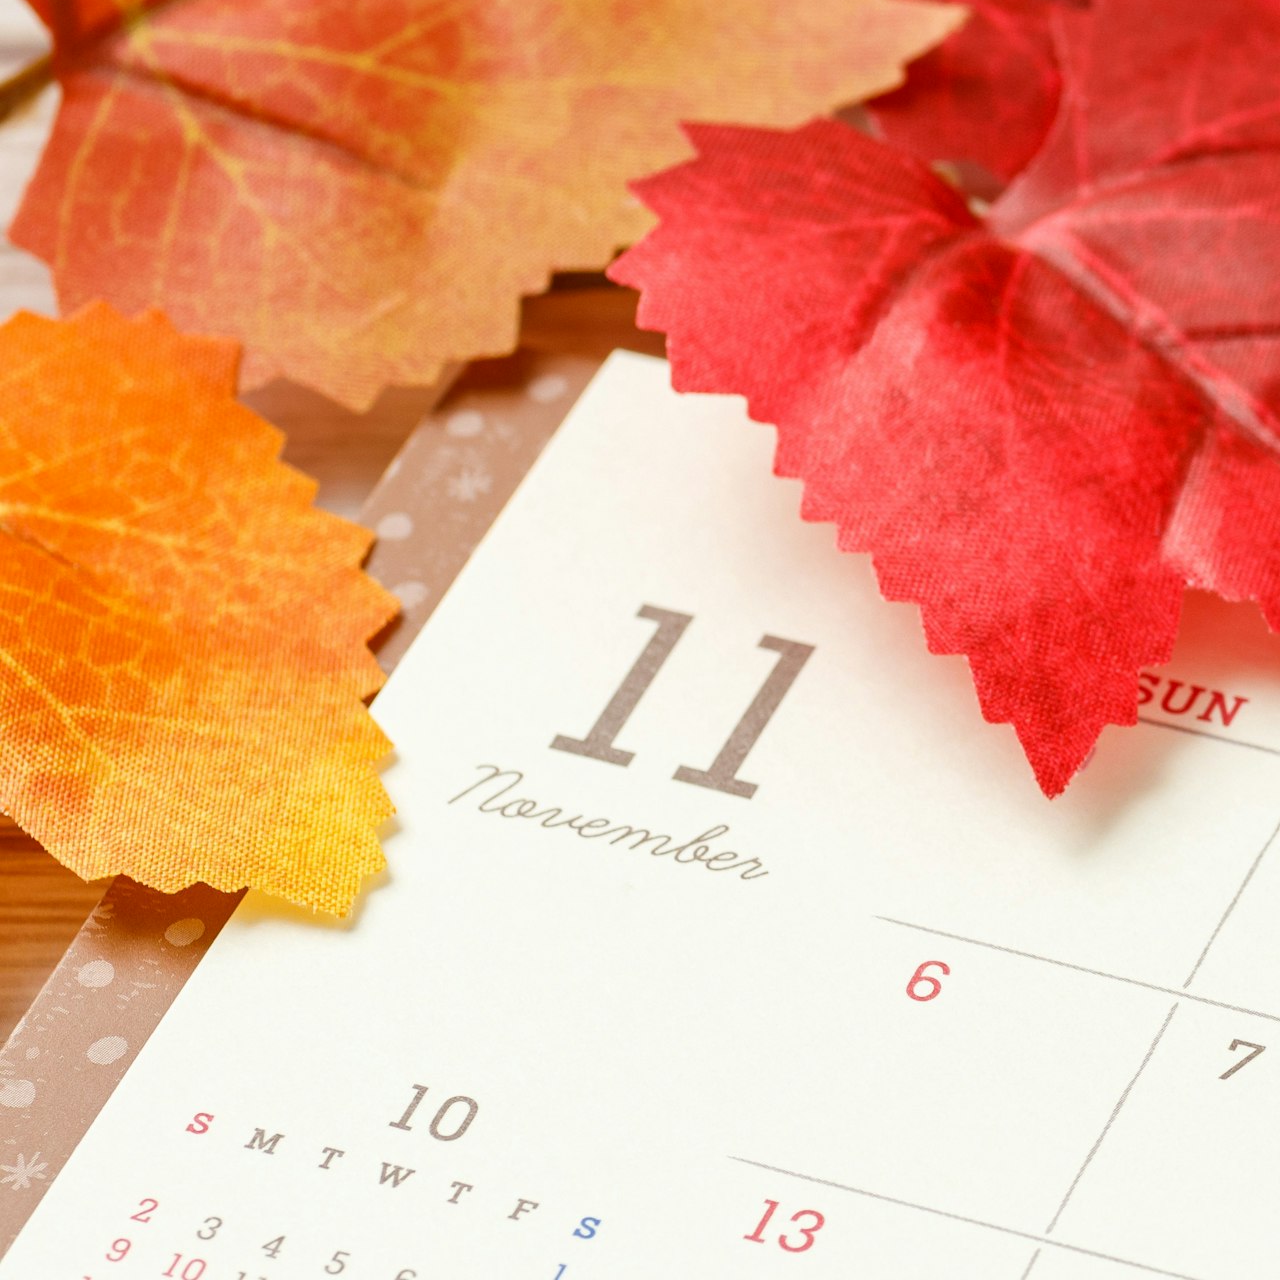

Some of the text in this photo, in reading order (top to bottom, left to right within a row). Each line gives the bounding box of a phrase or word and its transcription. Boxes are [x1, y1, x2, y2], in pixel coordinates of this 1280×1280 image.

[549, 603, 818, 800] 11
[1138, 673, 1249, 727] SUN
[447, 763, 770, 881] November
[905, 960, 950, 1002] 6
[1219, 1039, 1266, 1081] 7
[389, 1084, 479, 1142] 10
[186, 1112, 601, 1239] S M T W T F S
[105, 1238, 207, 1280] 9 10
[130, 1198, 351, 1275] 2 3 4 5
[743, 1199, 825, 1253] 13
